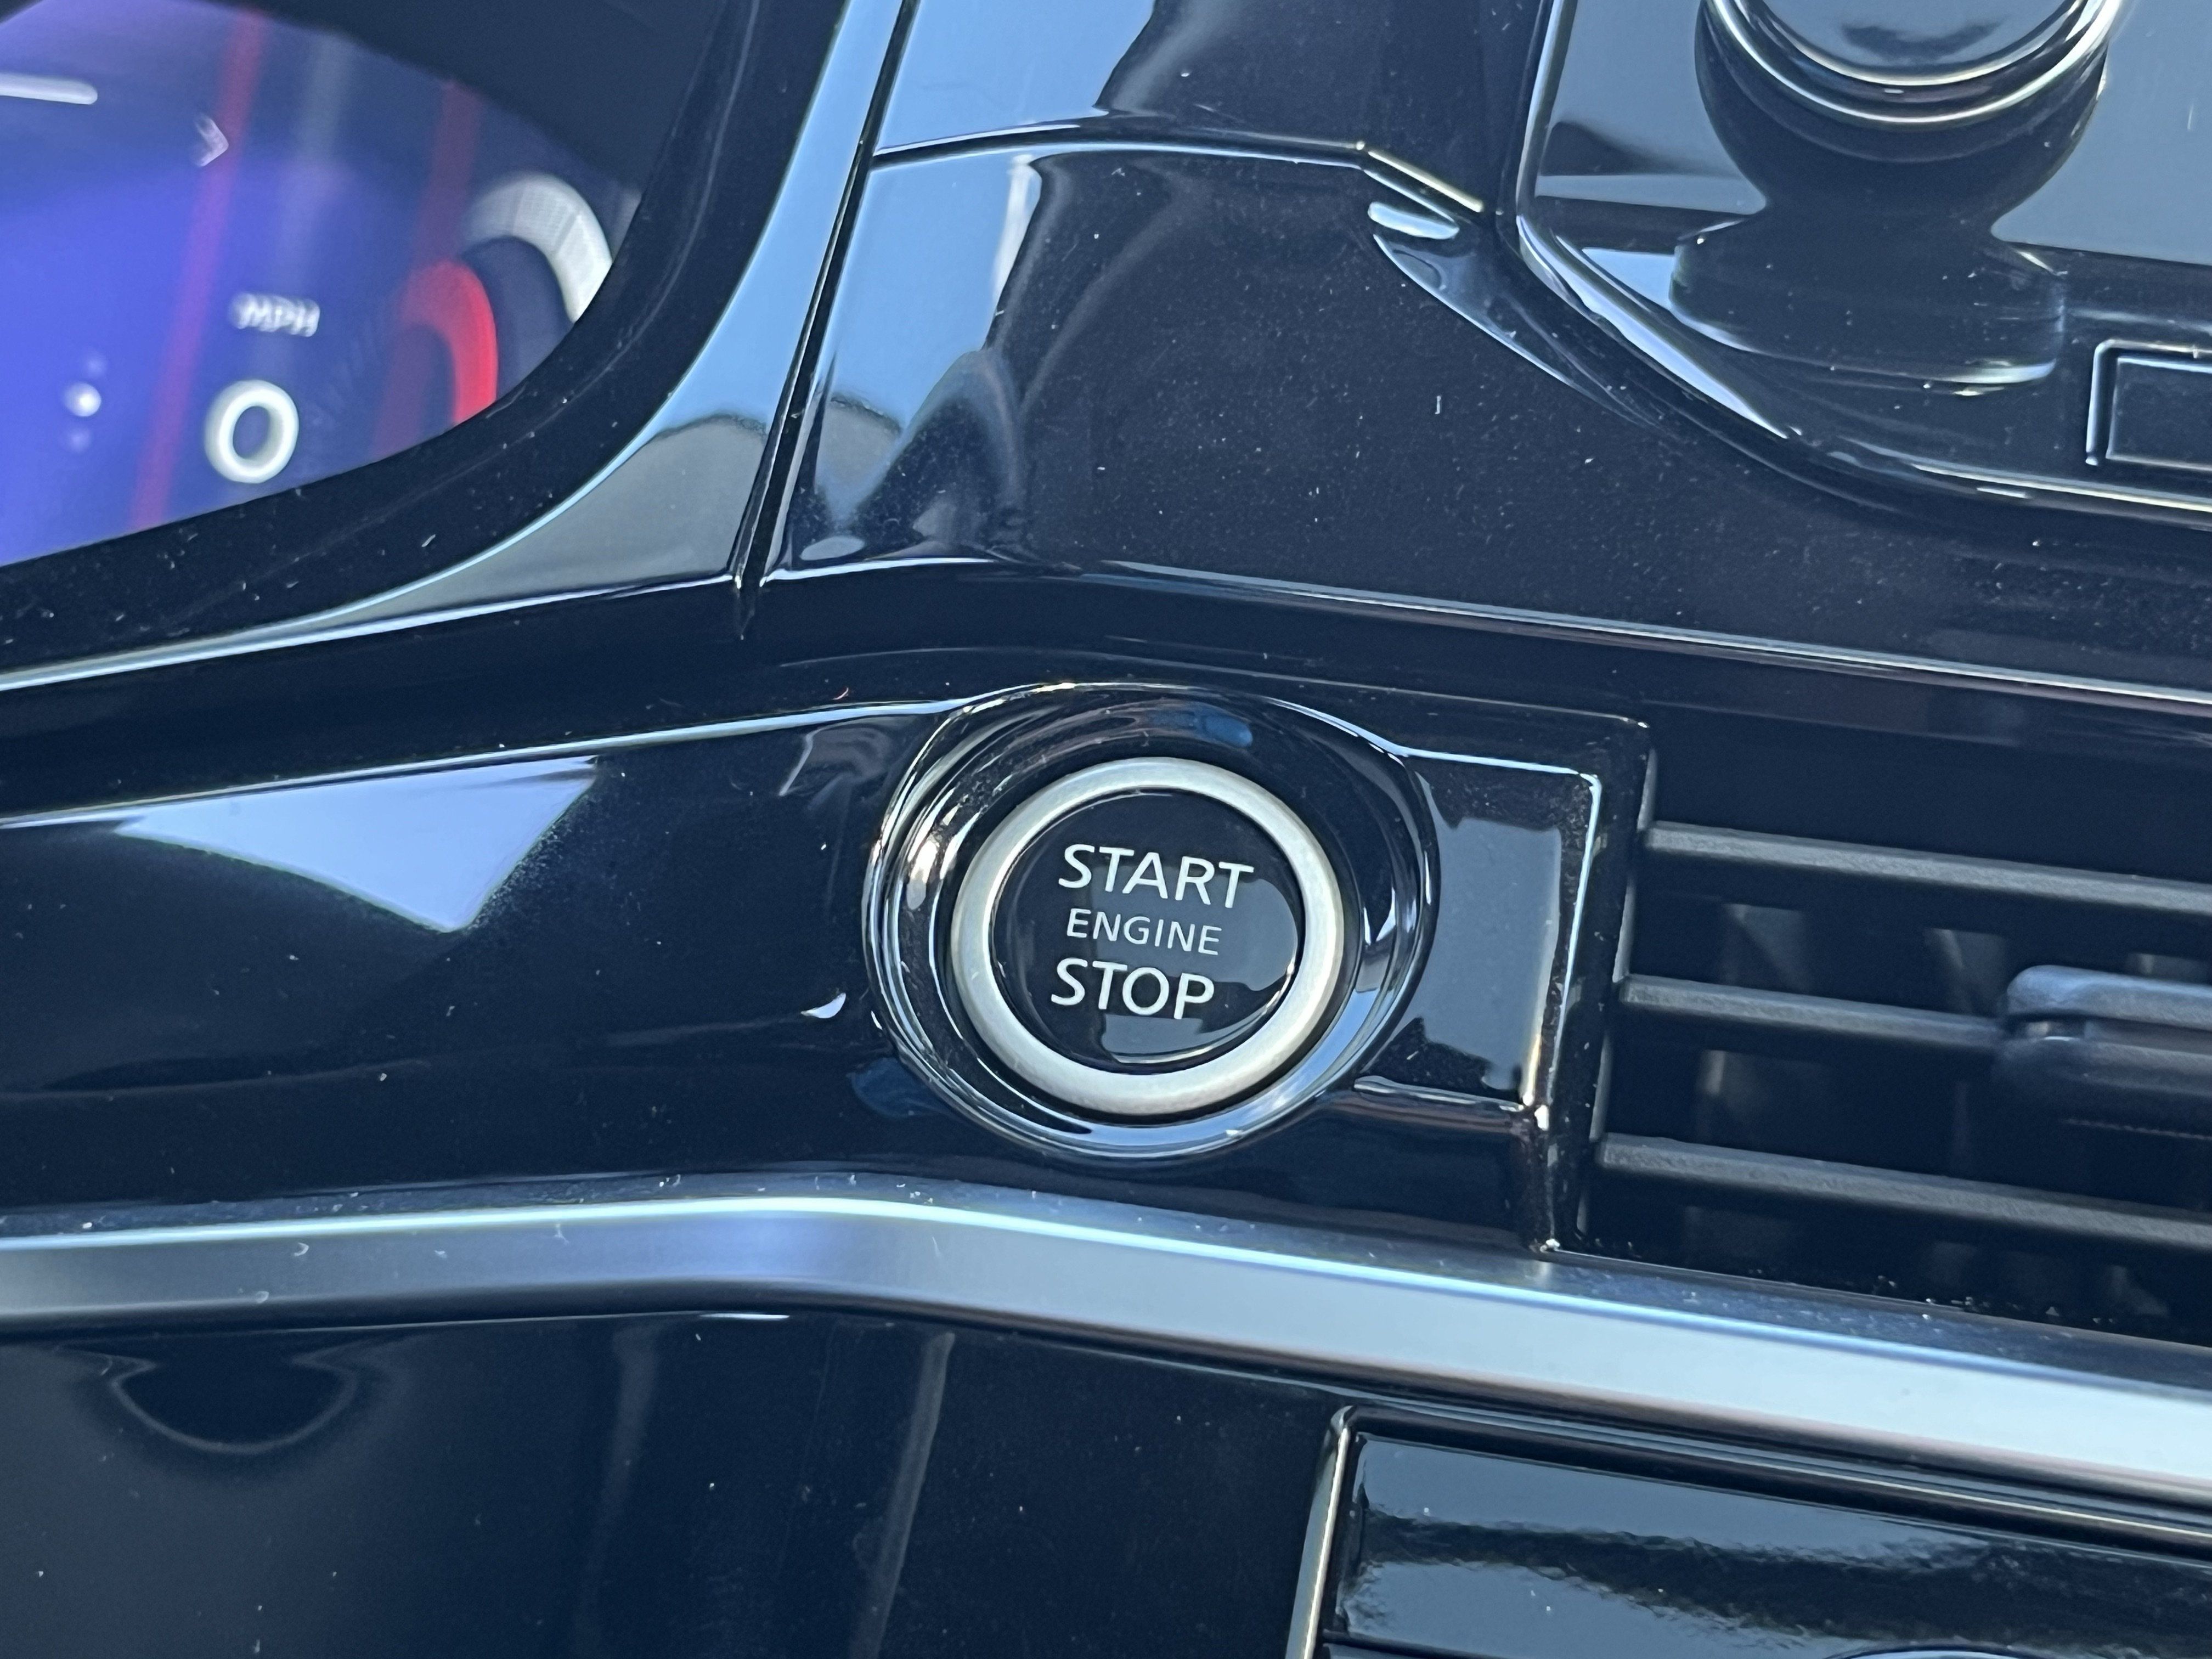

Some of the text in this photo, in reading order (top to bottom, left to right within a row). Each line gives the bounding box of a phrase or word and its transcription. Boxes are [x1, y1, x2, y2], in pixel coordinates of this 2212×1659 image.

[230, 292, 320, 337] MPH
[205, 379, 300, 483] 0
[1058, 844, 1255, 909] START
[1066, 907, 1222, 956] ENGINE
[1051, 957, 1215, 1020] STOP
